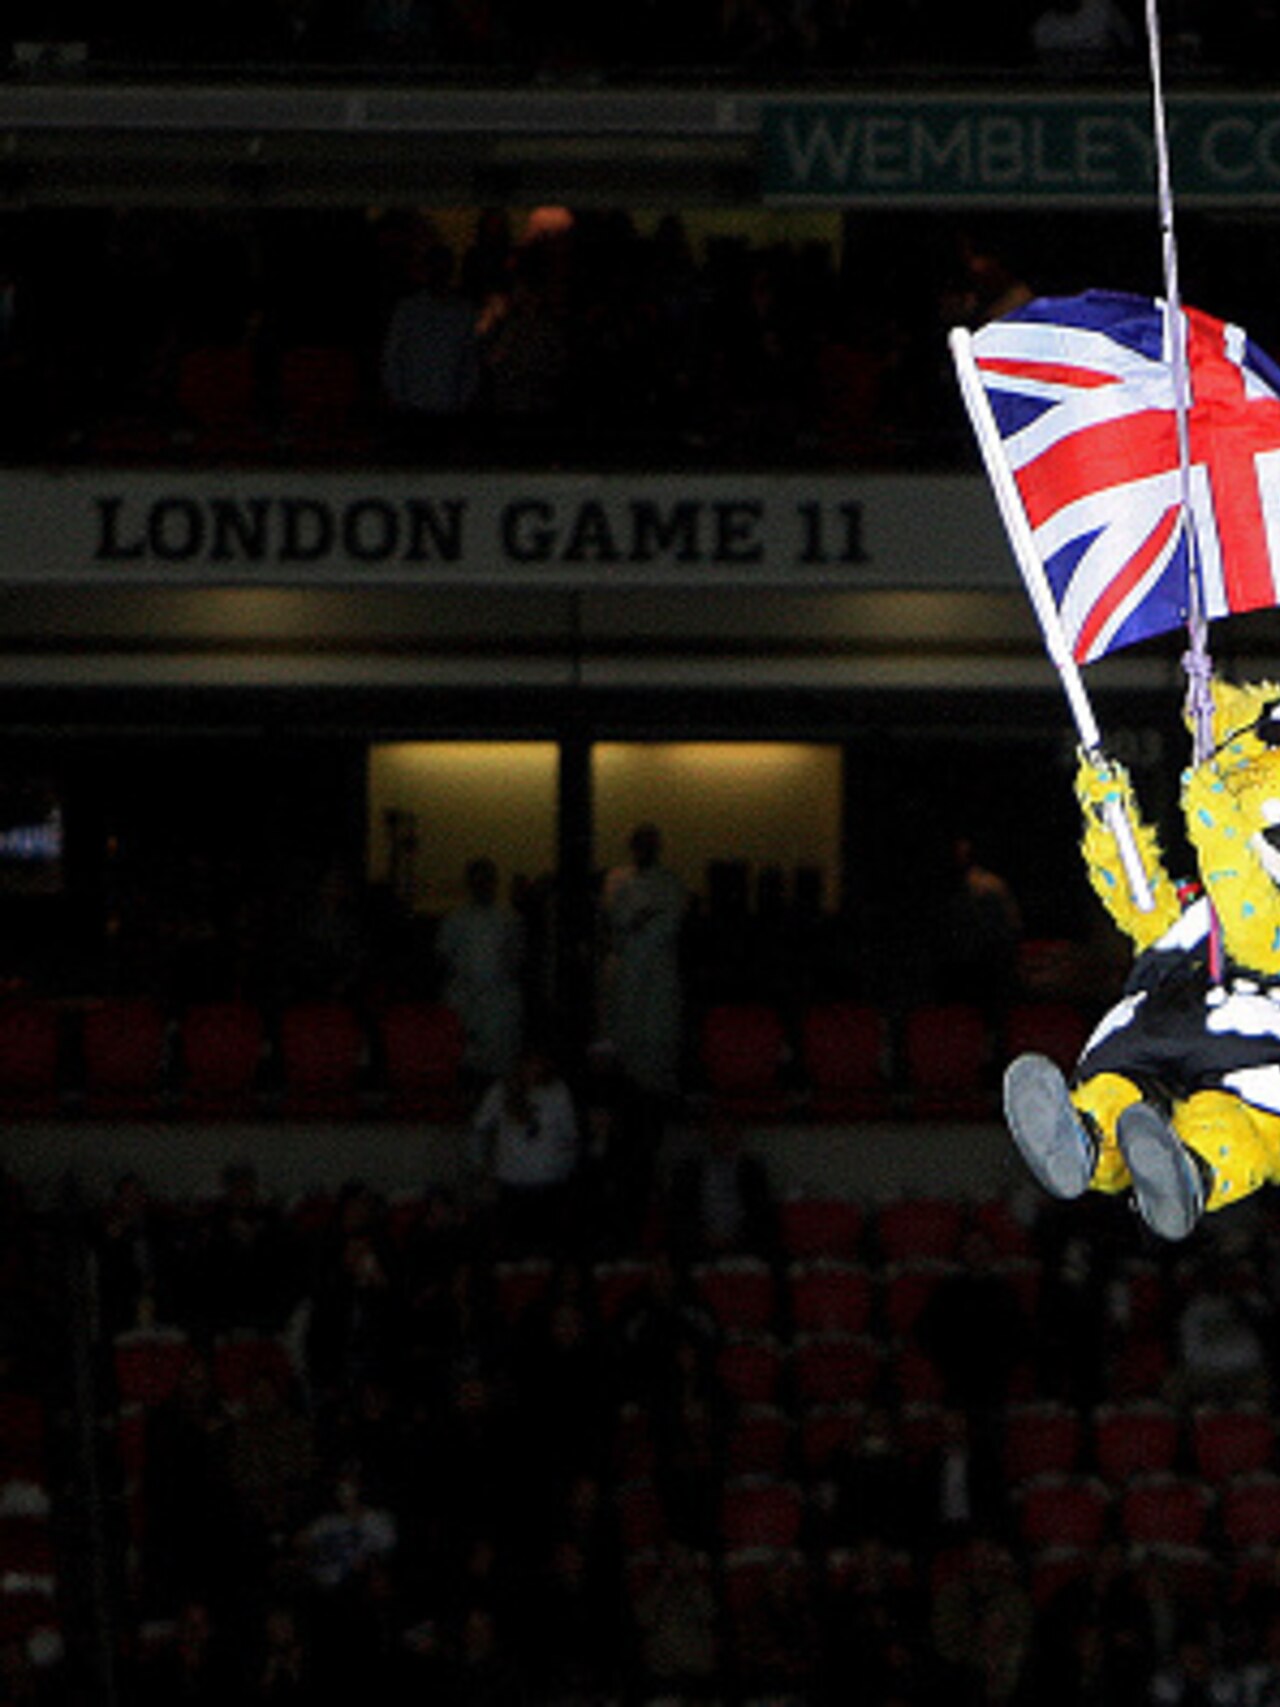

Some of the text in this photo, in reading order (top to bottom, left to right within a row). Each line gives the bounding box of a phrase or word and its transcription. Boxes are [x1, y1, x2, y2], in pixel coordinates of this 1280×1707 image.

[781, 115, 1178, 183] WEMBLEY
[92, 497, 867, 562] LONDON GAME 11
